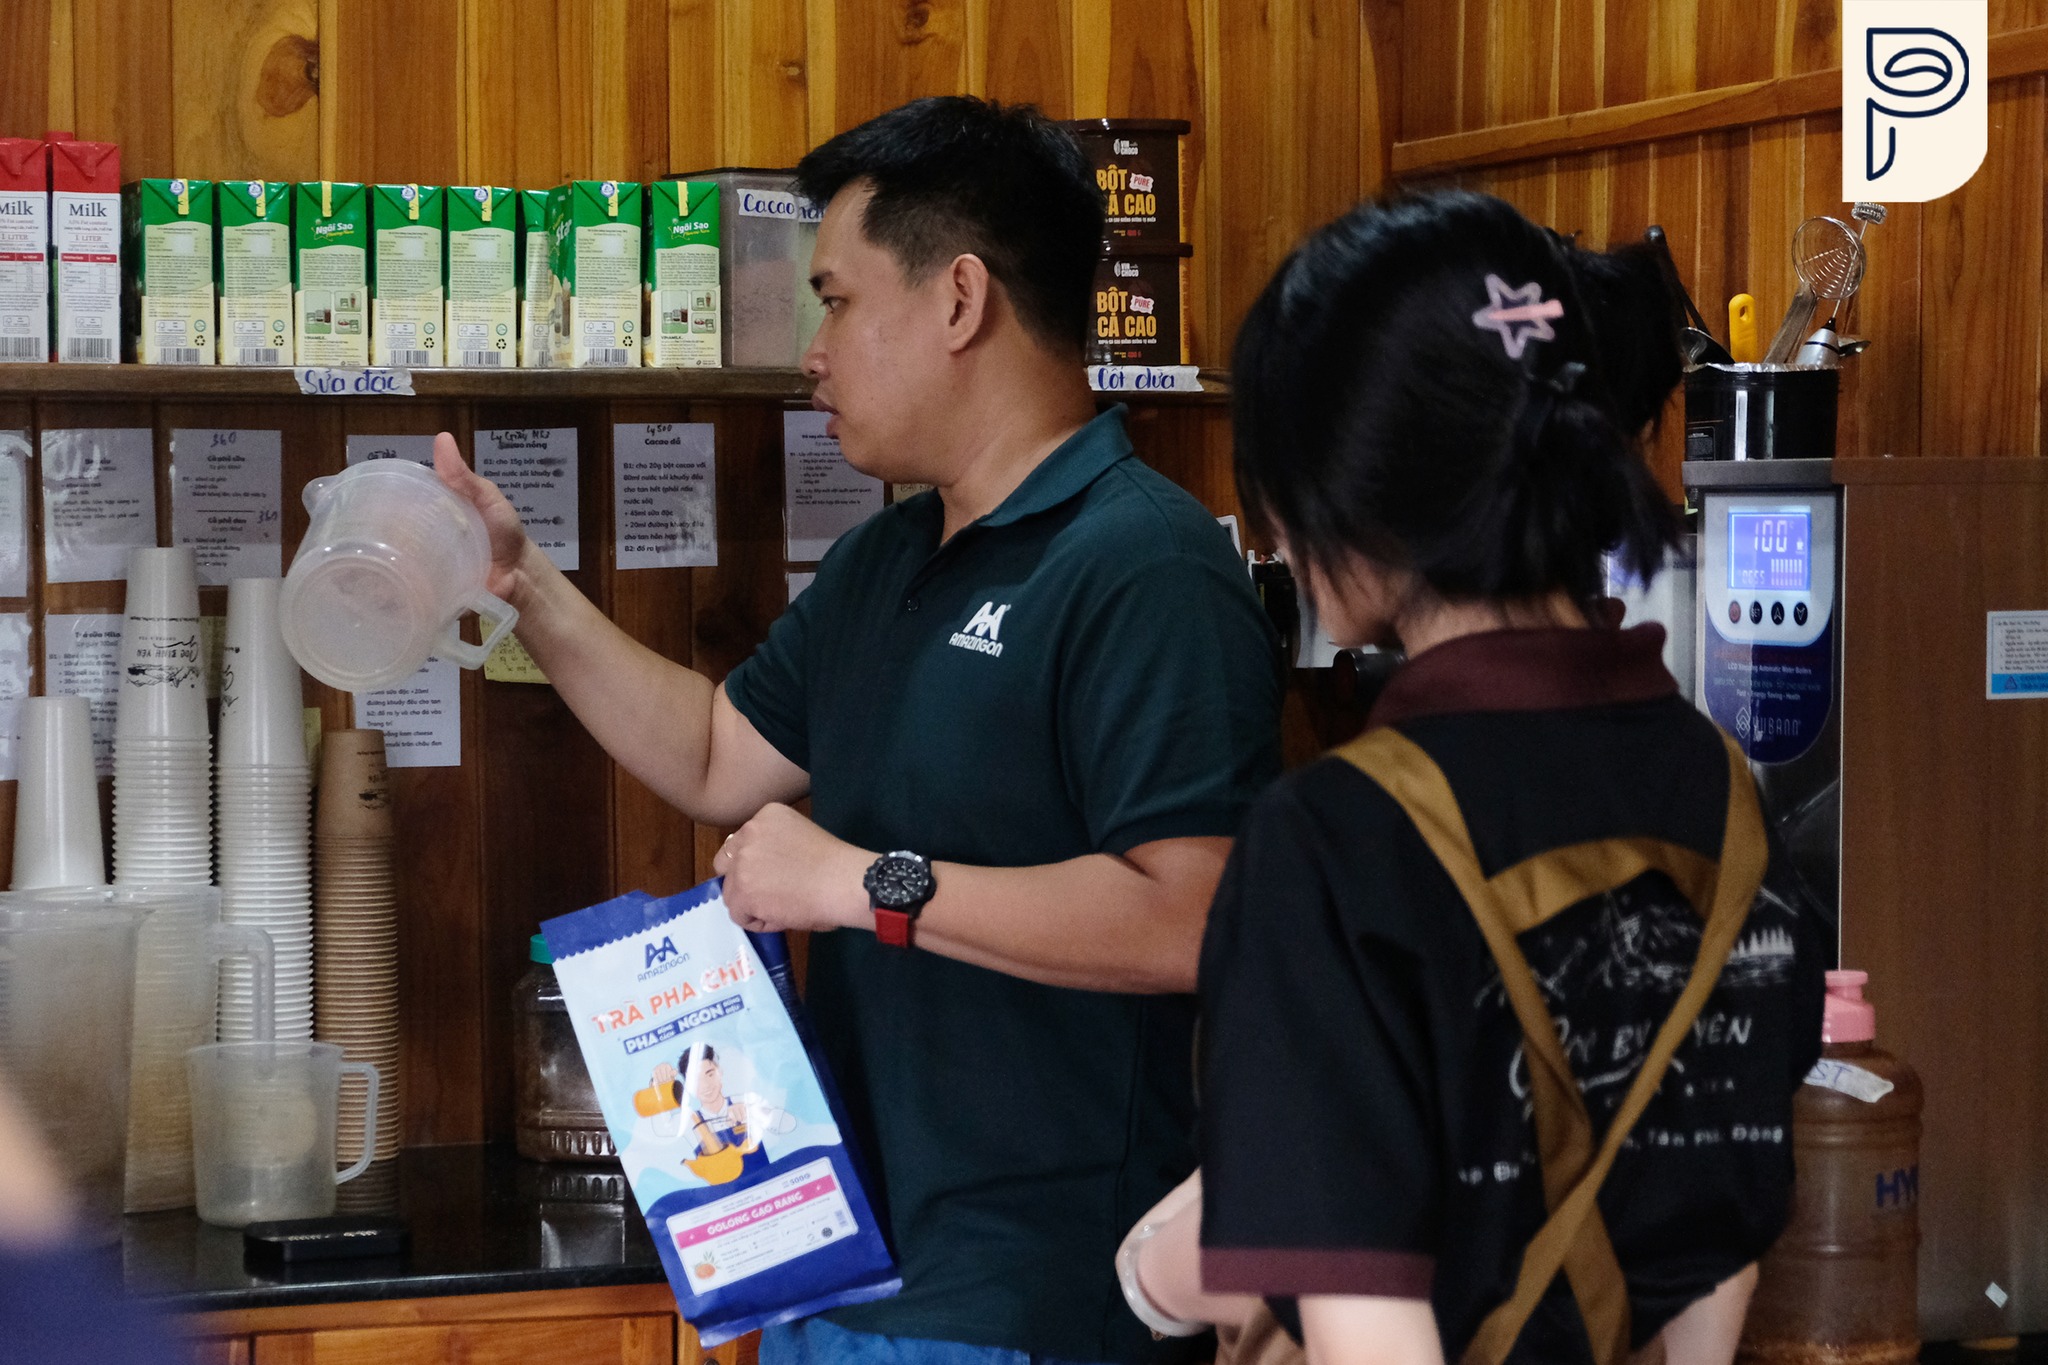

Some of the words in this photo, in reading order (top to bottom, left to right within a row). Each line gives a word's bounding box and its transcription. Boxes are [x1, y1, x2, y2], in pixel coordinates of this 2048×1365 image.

[1133, 177, 1150, 187] PURE
[69, 202, 108, 217] Milk
[743, 193, 795, 214] Cacao
[1124, 193, 1156, 216] CAO
[337, 222, 354, 231] Sao
[673, 222, 692, 234] Ngôi
[693, 221, 709, 230] Sao
[1134, 298, 1150, 309] PURE
[1124, 315, 1157, 337] CAO
[525, 440, 548, 450] nóng
[510, 458, 522, 466] 15g
[649, 462, 662, 470] 20g
[1754, 519, 1788, 553] 100
[948, 632, 1003, 658] AMAZINGON
[637, 952, 690, 983] AMAZINGON
[649, 981, 697, 1015] PHA
[677, 1003, 724, 1032] NGON
[626, 1031, 658, 1053] PHA
[706, 1213, 750, 1236] OOLONG
[773, 1190, 804, 1210] RANG
